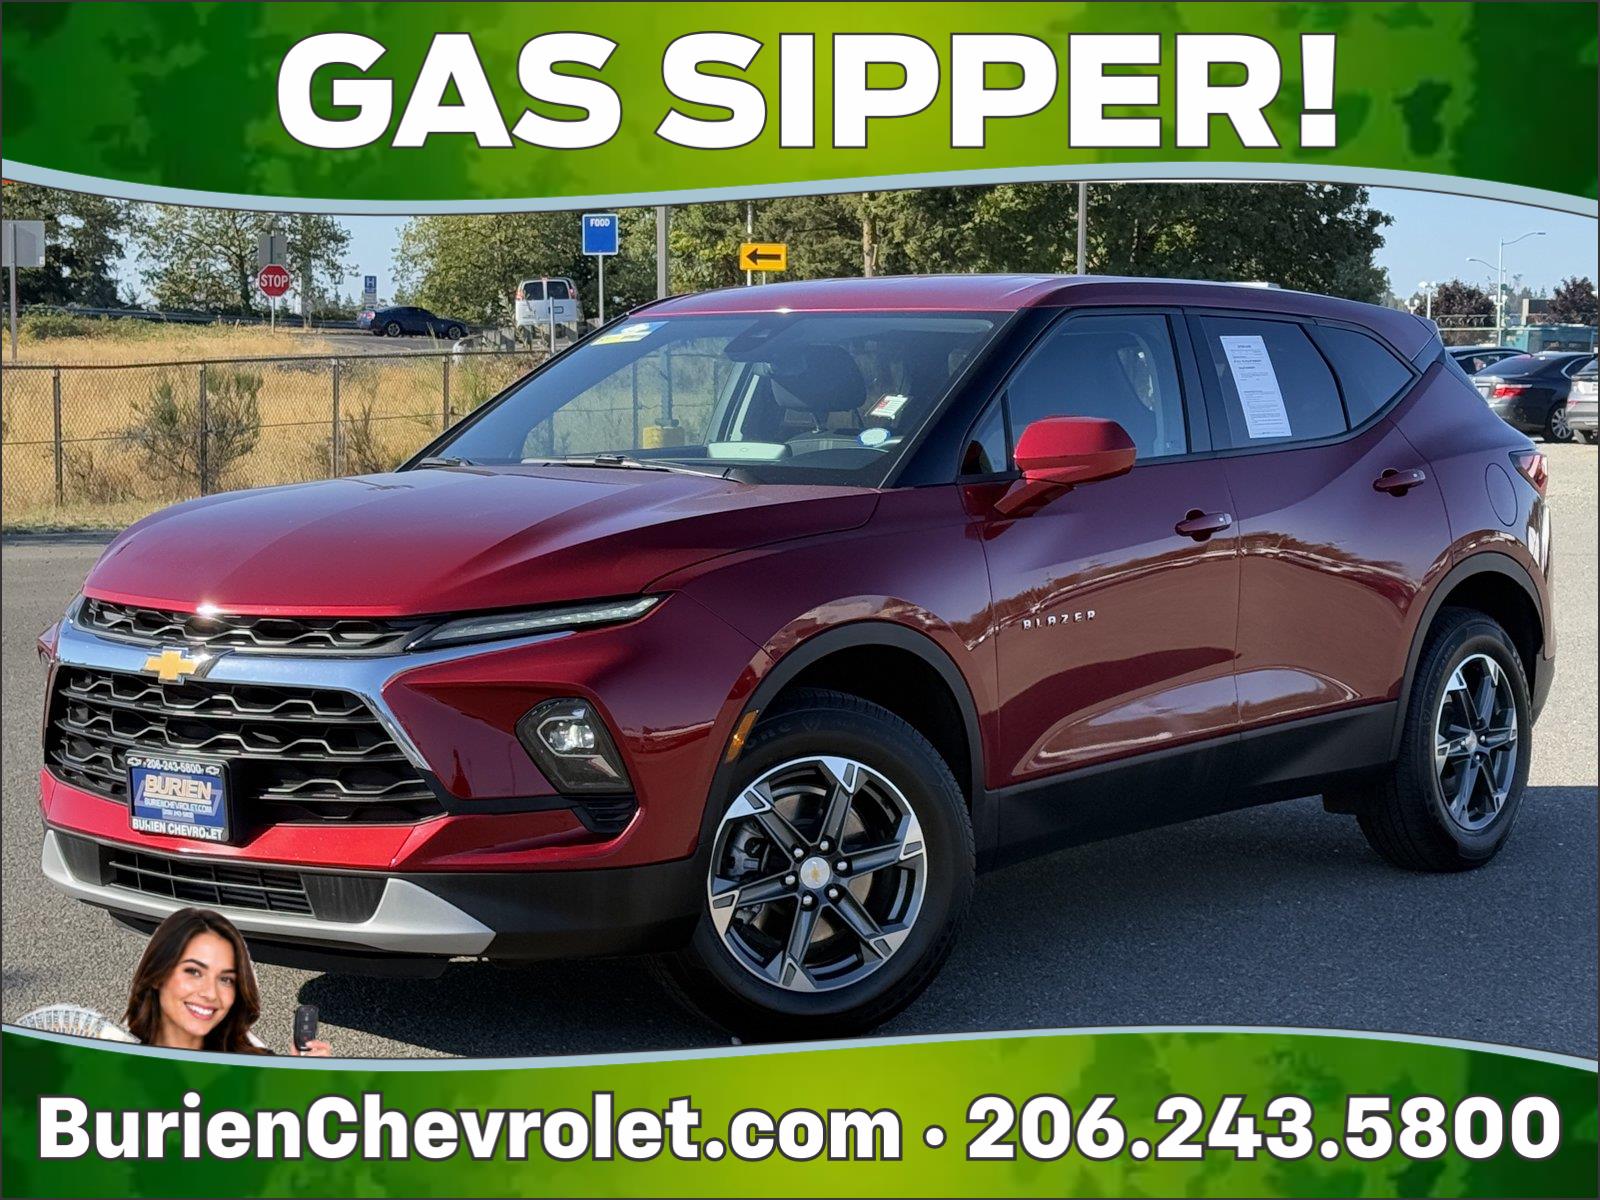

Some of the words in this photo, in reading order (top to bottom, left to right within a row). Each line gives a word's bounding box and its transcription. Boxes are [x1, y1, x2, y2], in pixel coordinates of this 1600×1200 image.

[590, 218, 610, 227] FOOD
[260, 274, 288, 288] STOP
[1022, 610, 1096, 630] BLAZER
[145, 774, 212, 799] BURIEN
[132, 818, 166, 835] BURIEN
[167, 822, 223, 841] CHEVROLET
